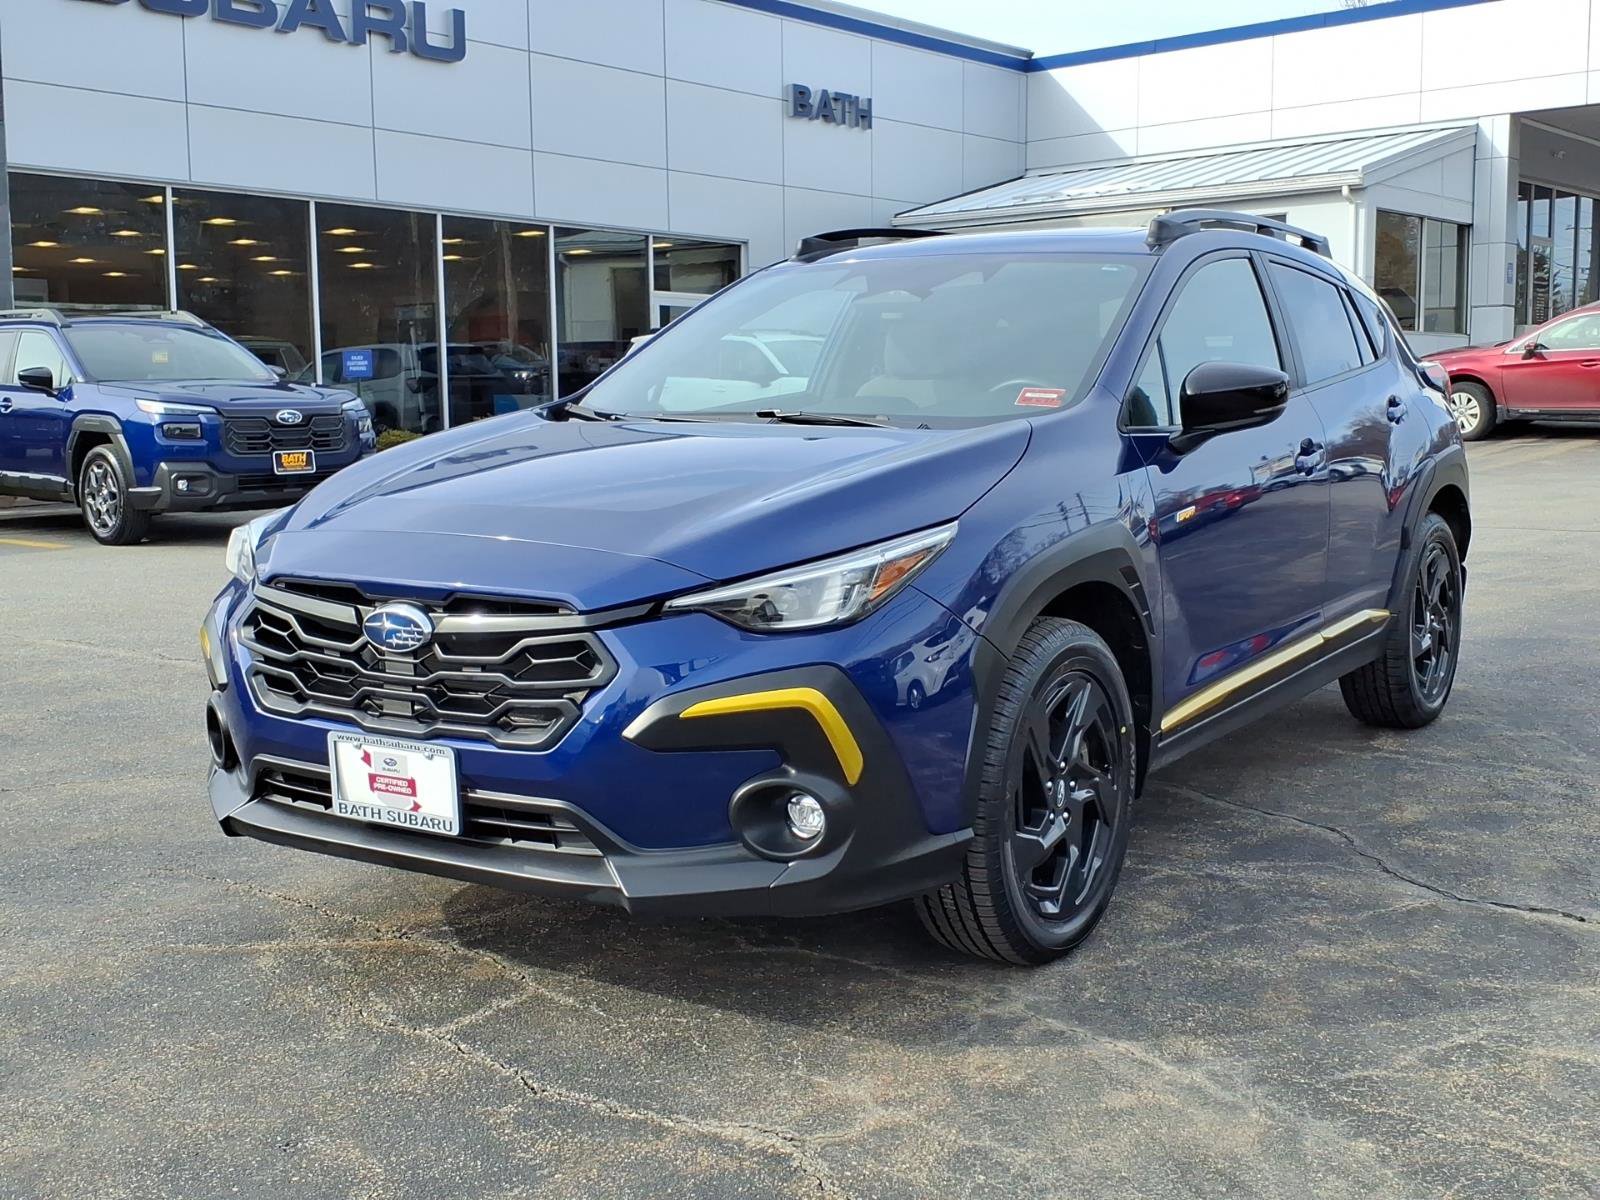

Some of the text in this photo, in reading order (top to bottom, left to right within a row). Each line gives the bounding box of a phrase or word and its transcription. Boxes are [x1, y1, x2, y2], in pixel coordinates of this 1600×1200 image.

[785, 83, 873, 130] BATH
[282, 453, 306, 465] BATH
[337, 734, 445, 755] www.bathsubaru.com
[373, 783, 412, 794] PRE-OWNED
[375, 776, 408, 787] CERTIFIED
[338, 802, 453, 833] BATH SUBARU
